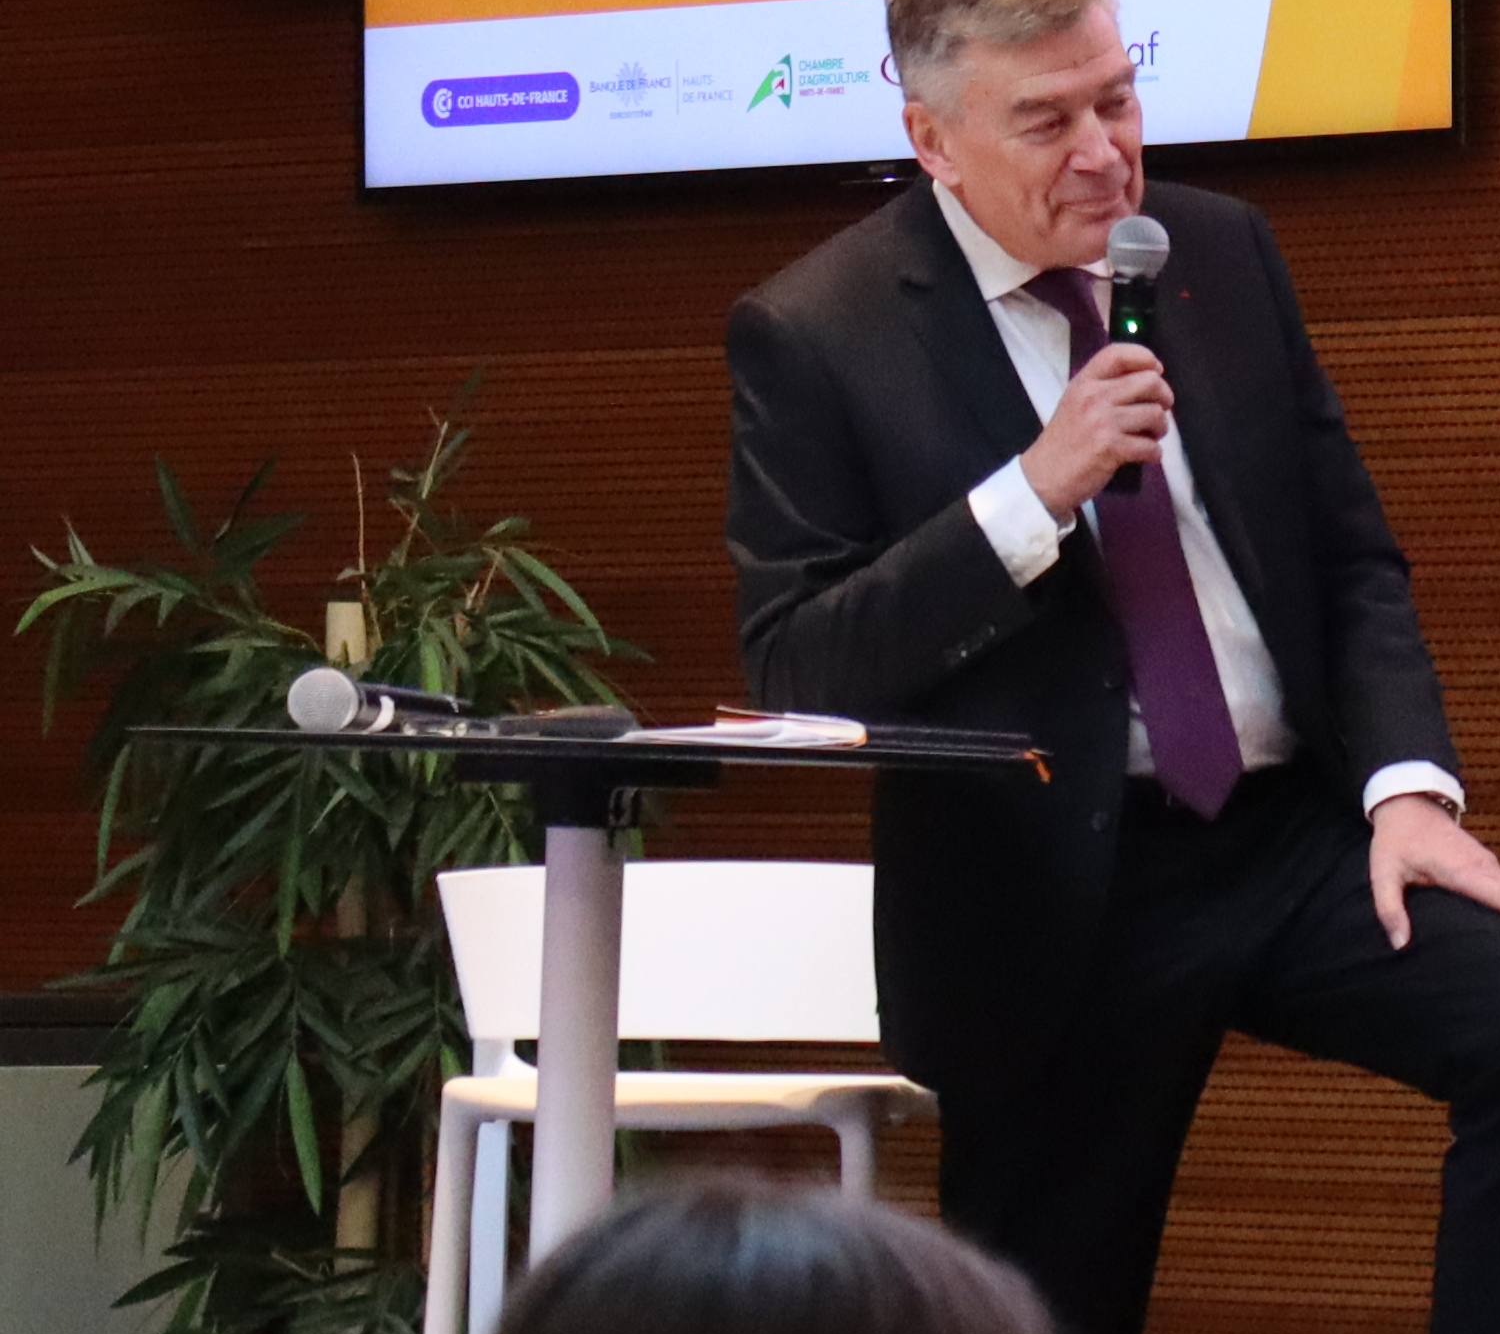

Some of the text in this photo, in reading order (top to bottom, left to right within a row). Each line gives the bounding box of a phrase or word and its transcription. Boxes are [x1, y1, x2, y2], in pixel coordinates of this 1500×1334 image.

[798, 58, 845, 72] CHAMBRE
[457, 89, 569, 109] CCI HAUTS-DE-FRANCE
